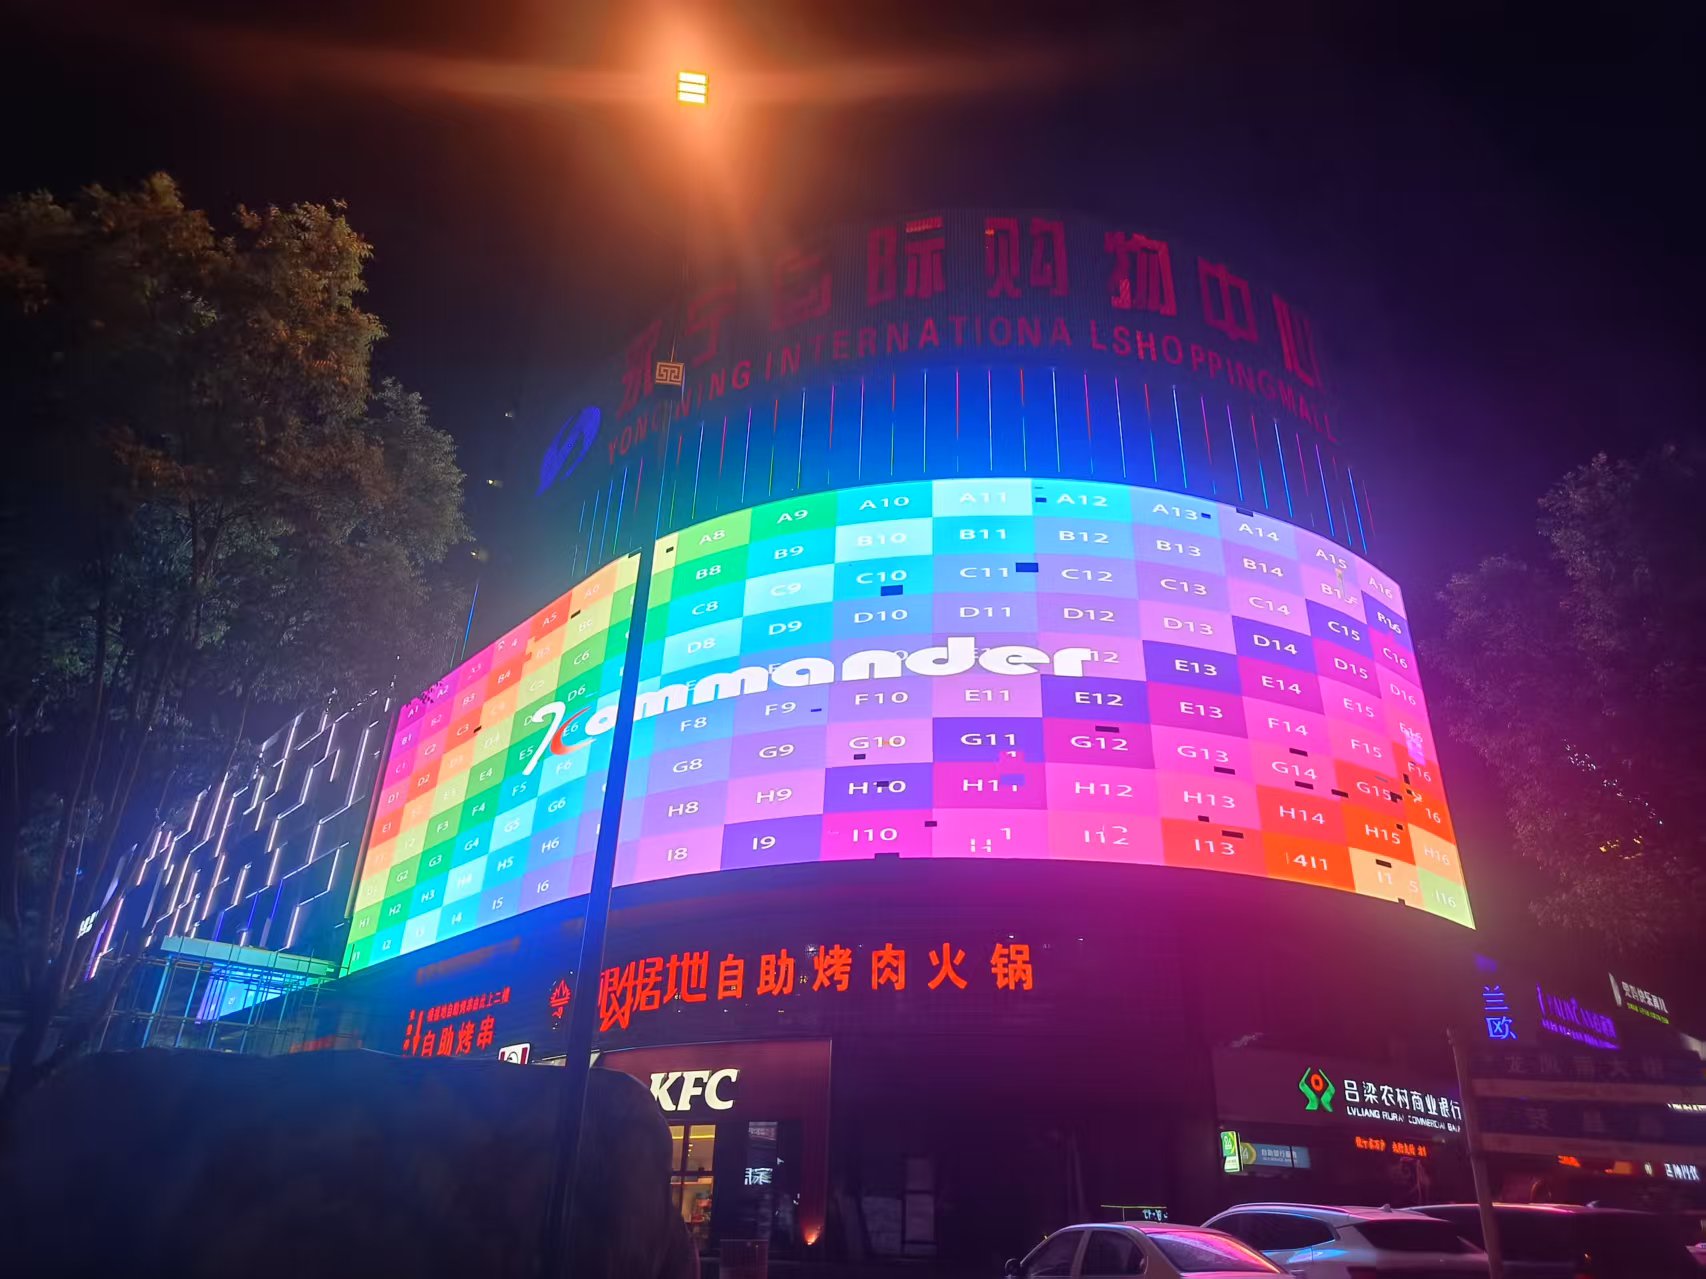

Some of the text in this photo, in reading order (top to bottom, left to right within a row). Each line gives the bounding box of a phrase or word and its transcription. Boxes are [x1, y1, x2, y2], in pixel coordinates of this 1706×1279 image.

[401, 733, 412, 745] B1
[431, 714, 442, 727] B2
[498, 670, 511, 684] B4
[695, 565, 722, 580] B8
[774, 546, 804, 560] B9
[857, 533, 907, 547] B10
[959, 529, 1007, 540] B11
[1059, 531, 1109, 544] B12
[1156, 539, 1201, 557] B13
[1243, 558, 1284, 577] B14
[408, 705, 419, 718] A1
[436, 685, 449, 698] A2
[542, 613, 557, 627] A5
[699, 529, 726, 545] A8
[776, 509, 808, 524] A9
[859, 496, 909, 510] A10
[959, 491, 1007, 504] A11
[1057, 493, 1108, 507] A12
[1152, 504, 1198, 521] A13
[1239, 523, 1279, 542] A14
[1316, 549, 1347, 569] A15
[1369, 577, 1393, 599] A16
[424, 744, 436, 755] C2
[456, 724, 469, 736] C3
[573, 650, 590, 665] C6
[691, 601, 719, 616] C8
[770, 583, 802, 597] C9
[856, 569, 907, 584] C10
[959, 567, 1008, 578] C11
[1061, 568, 1113, 582] C12
[1160, 578, 1207, 595] C13
[1249, 596, 1291, 616] C14
[1327, 620, 1360, 642] C15
[1383, 647, 1408, 669] C16
[382, 823, 392, 833] E1
[479, 768, 492, 781] E4
[519, 745, 534, 760] E5
[563, 722, 579, 737] E6
[1174, 659, 1217, 676] E13
[1261, 676, 1302, 695] E14
[1343, 698, 1375, 718] E15
[388, 792, 400, 804] D1
[417, 774, 430, 787] D2
[568, 685, 586, 701] D6
[687, 638, 716, 655] D8
[768, 621, 802, 636] D9
[854, 609, 908, 624] D10
[959, 606, 1011, 618] D11
[1063, 607, 1115, 623] D12
[1163, 617, 1213, 635] D13
[1253, 634, 1298, 655] D14
[1334, 657, 1369, 680] D15
[1390, 683, 1416, 706] D16
[437, 821, 448, 833] F3
[472, 802, 486, 816] F4
[512, 782, 527, 797] F5
[556, 760, 573, 774] F6
[680, 716, 707, 732] F8
[765, 701, 796, 716] F9
[855, 691, 909, 705] F10
[965, 690, 1010, 701] E11
[1074, 691, 1123, 706] E12
[1179, 702, 1224, 719] E13
[1268, 718, 1308, 737] F14
[1351, 739, 1383, 759] F15
[1407, 762, 1432, 783] F16
[359, 918, 370, 928] H1
[389, 904, 401, 916] H2
[421, 889, 435, 903] H3
[497, 856, 514, 872] H5
[541, 837, 560, 854] H6
[668, 801, 699, 817] H8
[756, 788, 792, 804] H9
[848, 780, 906, 795] H10
[1074, 782, 1133, 798] H12
[1183, 791, 1235, 809] H13
[1279, 805, 1326, 825] H14
[1365, 824, 1401, 844] H15
[1424, 846, 1450, 865] H16
[396, 870, 409, 882] G2
[429, 854, 442, 867] G3
[464, 838, 480, 851] G4
[504, 819, 520, 833] G5
[548, 799, 566, 812] G6
[672, 758, 703, 773] G8
[758, 744, 795, 759] G9
[849, 735, 906, 749] G10
[960, 733, 1016, 746] G11
[1070, 735, 1129, 751] G12
[1177, 745, 1229, 763] G13
[1271, 761, 1318, 781] G14
[1356, 781, 1391, 801] G15
[451, 912, 463, 925] I4
[492, 897, 504, 910] I5
[537, 879, 549, 894] I6
[667, 847, 688, 862] I8
[752, 836, 776, 851] I9
[853, 828, 897, 842] I10
[1194, 839, 1235, 856] I13
[421, 1015, 496, 1057] 自助烤串
[650, 1068, 739, 1111] KFC
[1344, 1079, 1462, 1121] 吕梁农村商业银行
